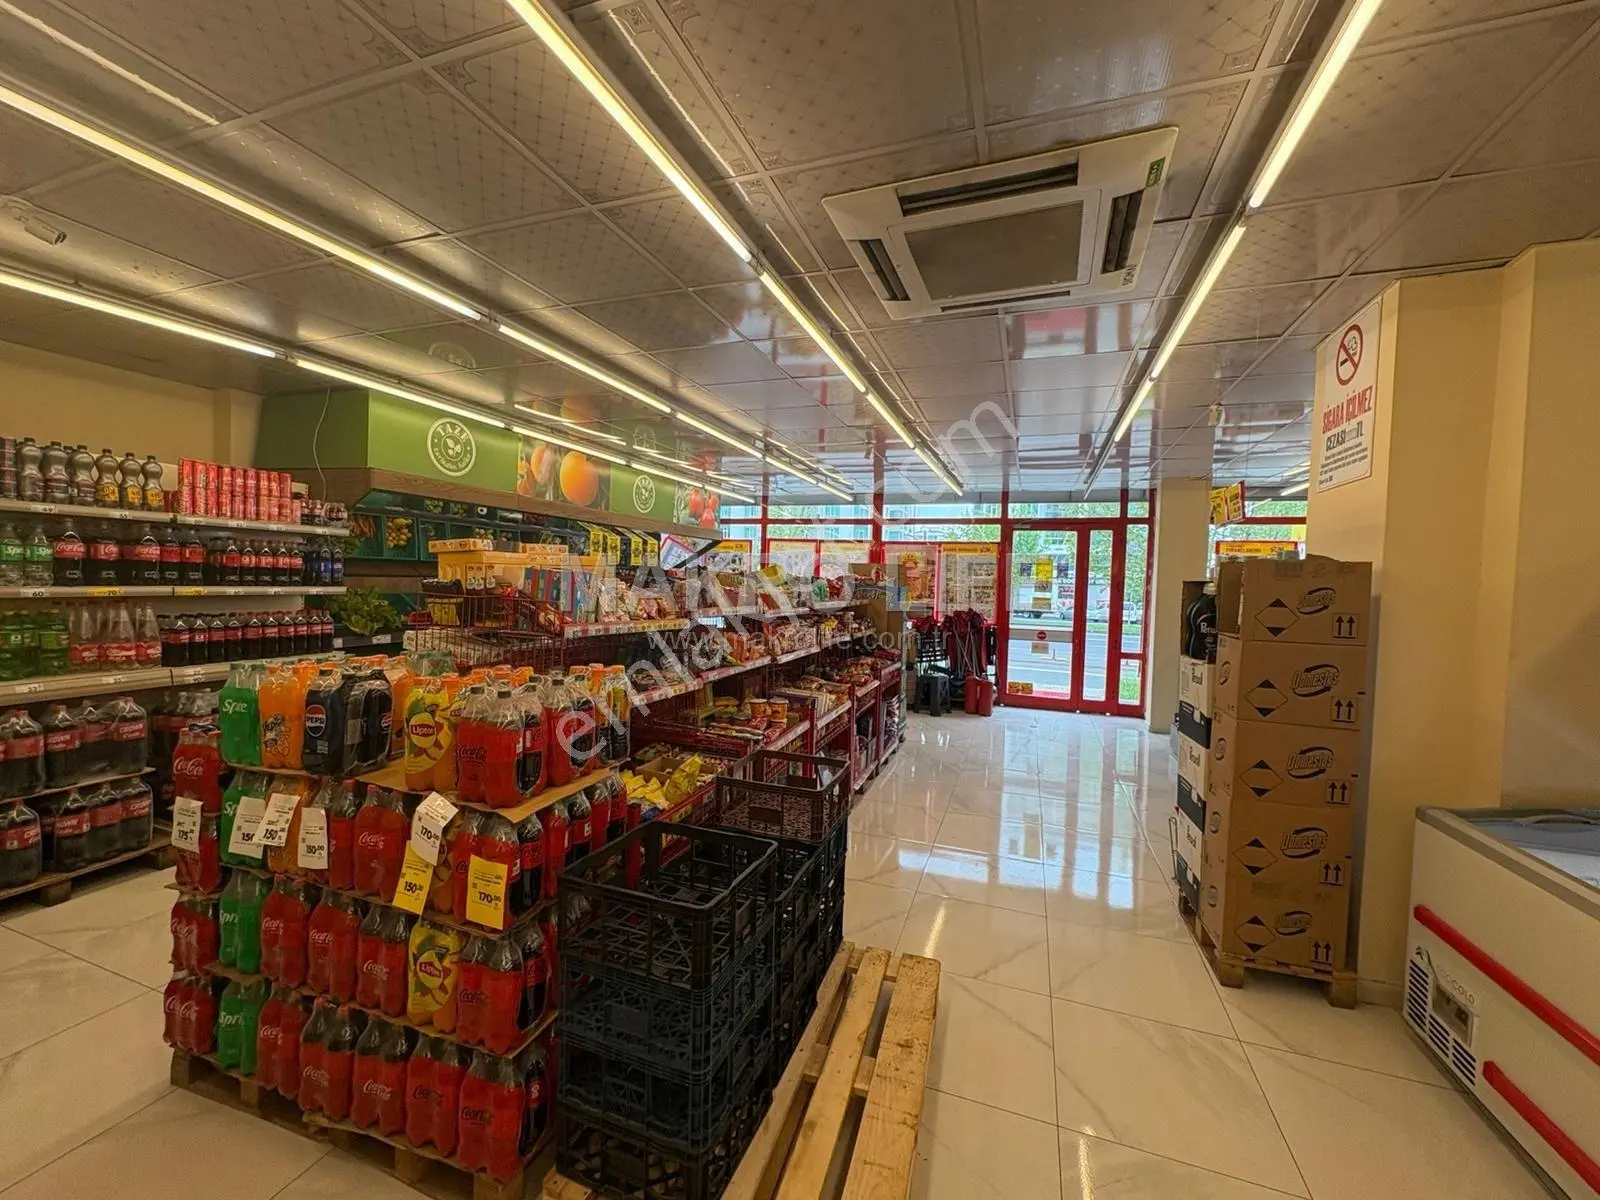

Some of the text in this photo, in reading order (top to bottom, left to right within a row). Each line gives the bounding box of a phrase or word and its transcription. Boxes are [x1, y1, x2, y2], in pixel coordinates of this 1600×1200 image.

[435, 422, 469, 442] TAZE
[1326, 427, 1346, 452] CEZASI
[1291, 671, 1340, 689] Domestos
[1286, 751, 1334, 770] Domestos
